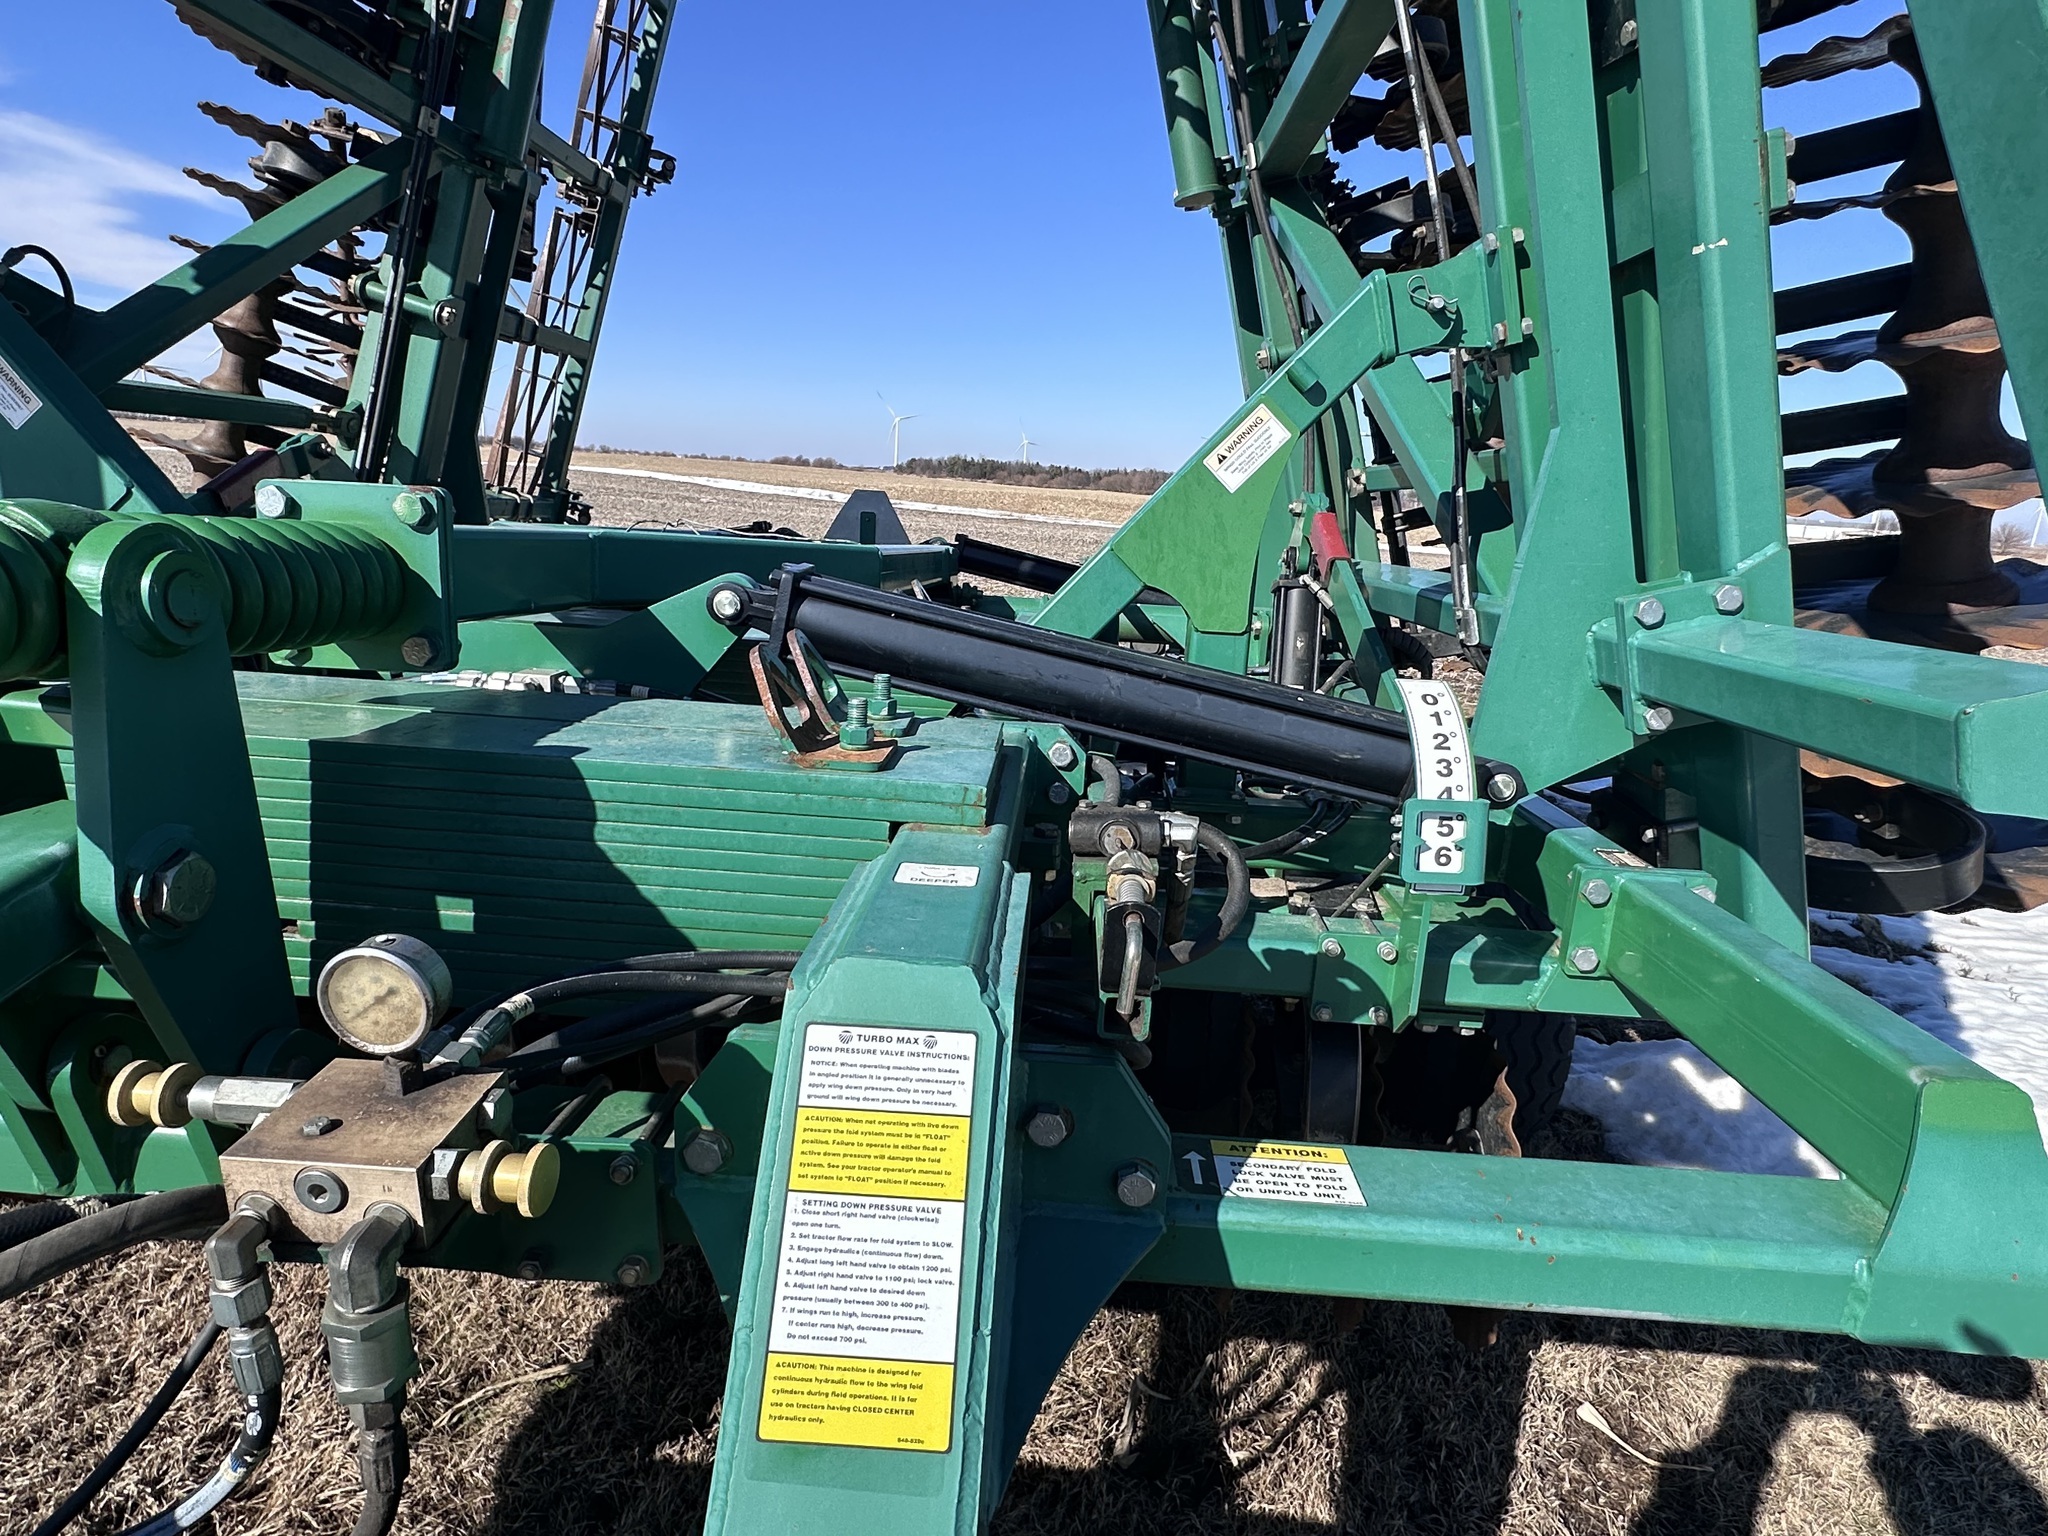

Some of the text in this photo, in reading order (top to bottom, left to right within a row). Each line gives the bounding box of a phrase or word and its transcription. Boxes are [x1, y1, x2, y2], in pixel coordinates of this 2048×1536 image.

[1224, 416, 1264, 454] WARNING
[910, 876, 959, 884] DEEPER
[856, 1033, 893, 1044] TURBO
[808, 1045, 833, 1053] DOWN
[834, 1046, 877, 1056] PRESSURE
[879, 1049, 905, 1057] VALVE
[810, 1059, 838, 1067] NOTICE:
[810, 1115, 844, 1123] CAUTION:
[1229, 1144, 1329, 1159] ATTENTION:
[1229, 1161, 1302, 1172] SECONDARY
[1232, 1169, 1344, 1183] LOCK VALVE MUST
[1259, 1188, 1308, 1197] UNFOLD
[1314, 1192, 1345, 1200] UNIT.
[801, 1198, 942, 1215] SETTING DOWN PRESSURE VALVE
[780, 1361, 817, 1370] CAUTION:
[852, 1405, 883, 1414] CLOSED
[883, 1407, 915, 1416] CENTER
